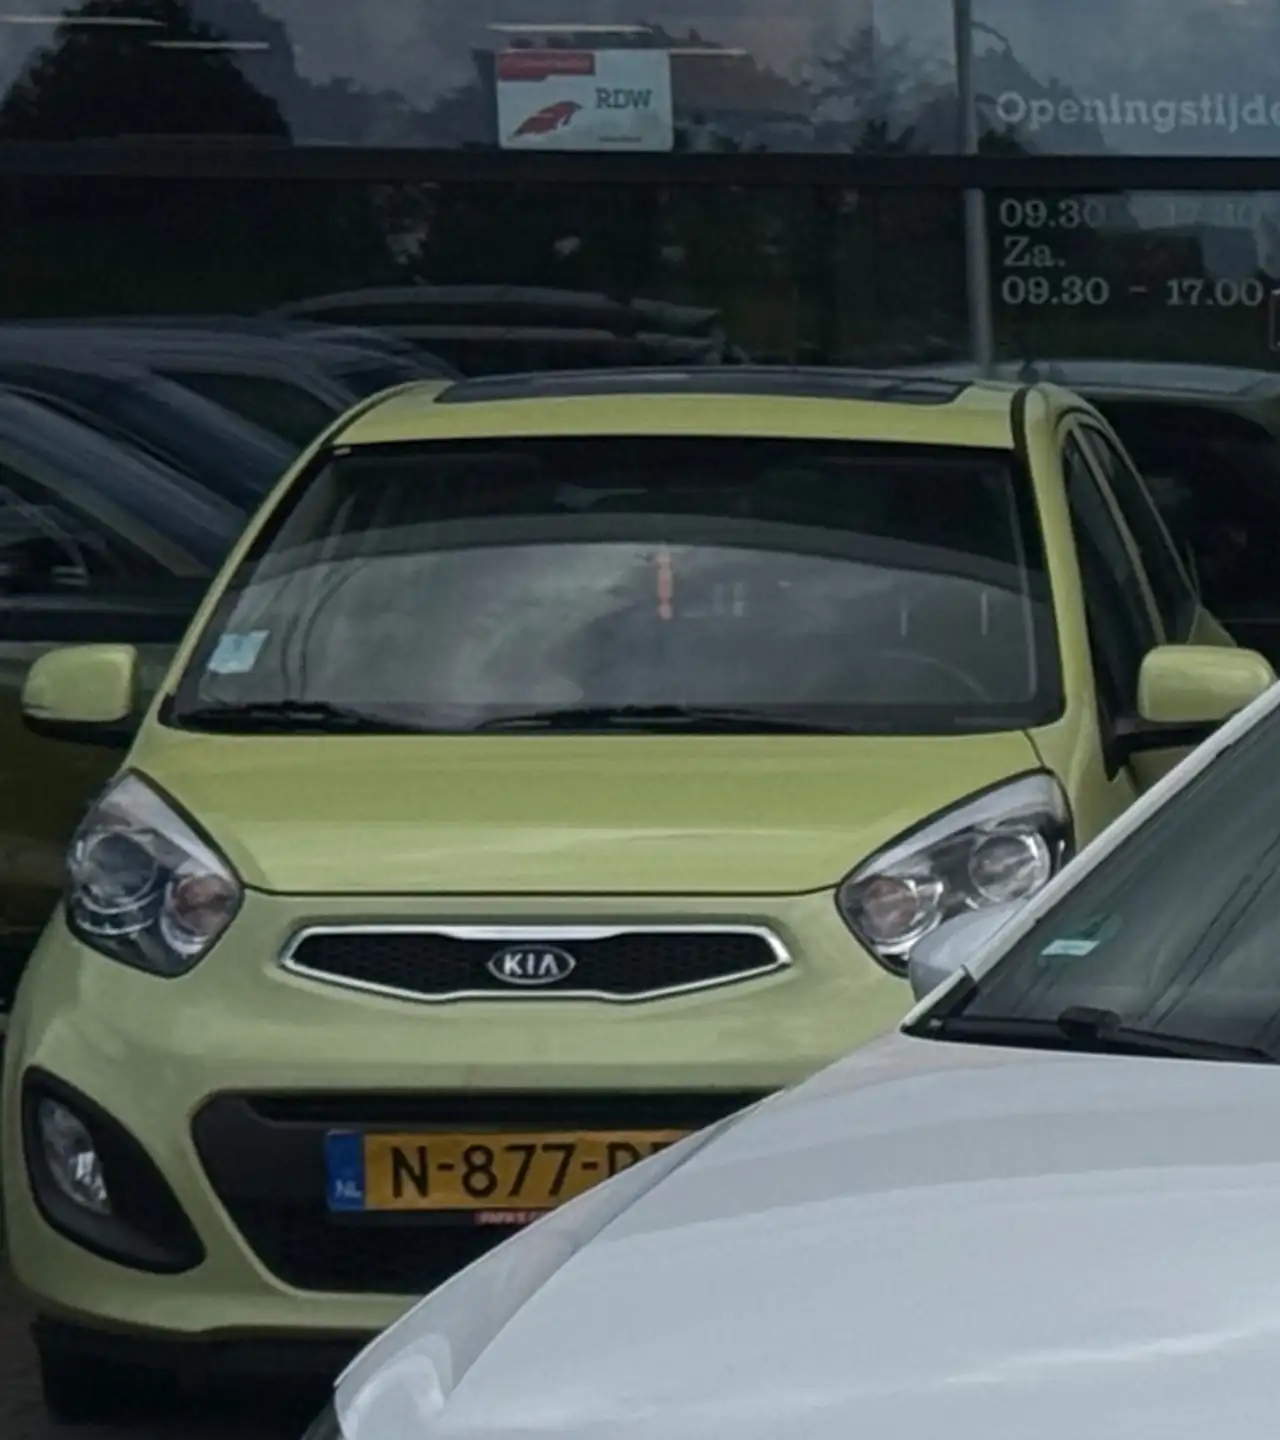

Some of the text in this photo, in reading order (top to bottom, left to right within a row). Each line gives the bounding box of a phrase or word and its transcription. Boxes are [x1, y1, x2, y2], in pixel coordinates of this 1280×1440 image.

[595, 86, 653, 110] RDW
[1002, 234, 1067, 269] Za.
[1001, 275, 1111, 306] 09.30
[1165, 277, 1265, 307] 17.00
[502, 951, 563, 978] KIA
[334, 1178, 361, 1198] NL
